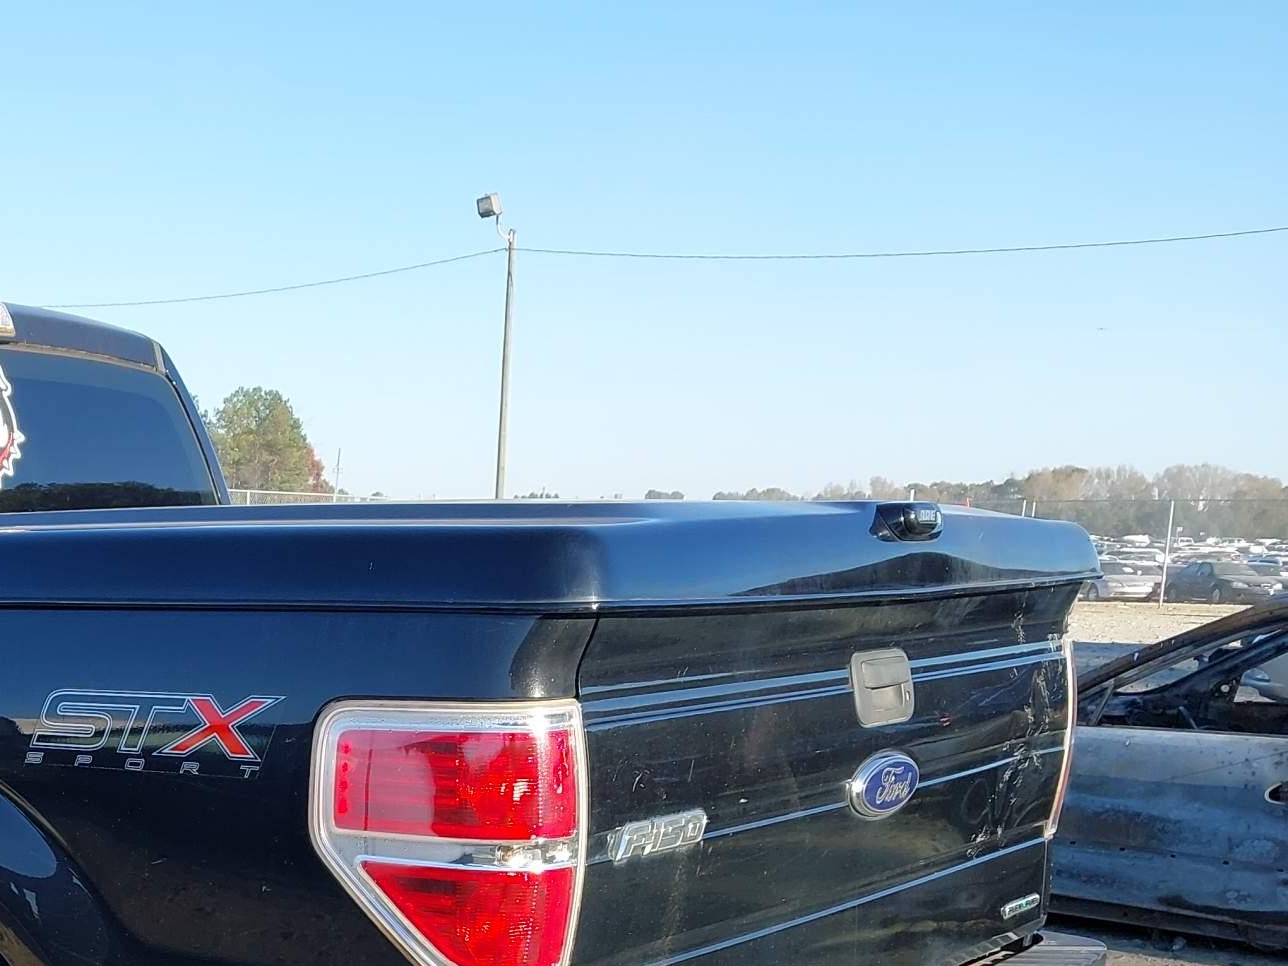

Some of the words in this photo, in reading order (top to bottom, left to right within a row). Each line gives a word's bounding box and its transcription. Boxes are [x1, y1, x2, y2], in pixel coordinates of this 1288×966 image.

[29, 688, 287, 762] STX
[23, 751, 261, 779] SPORT
[876, 766, 913, 805] Ford
